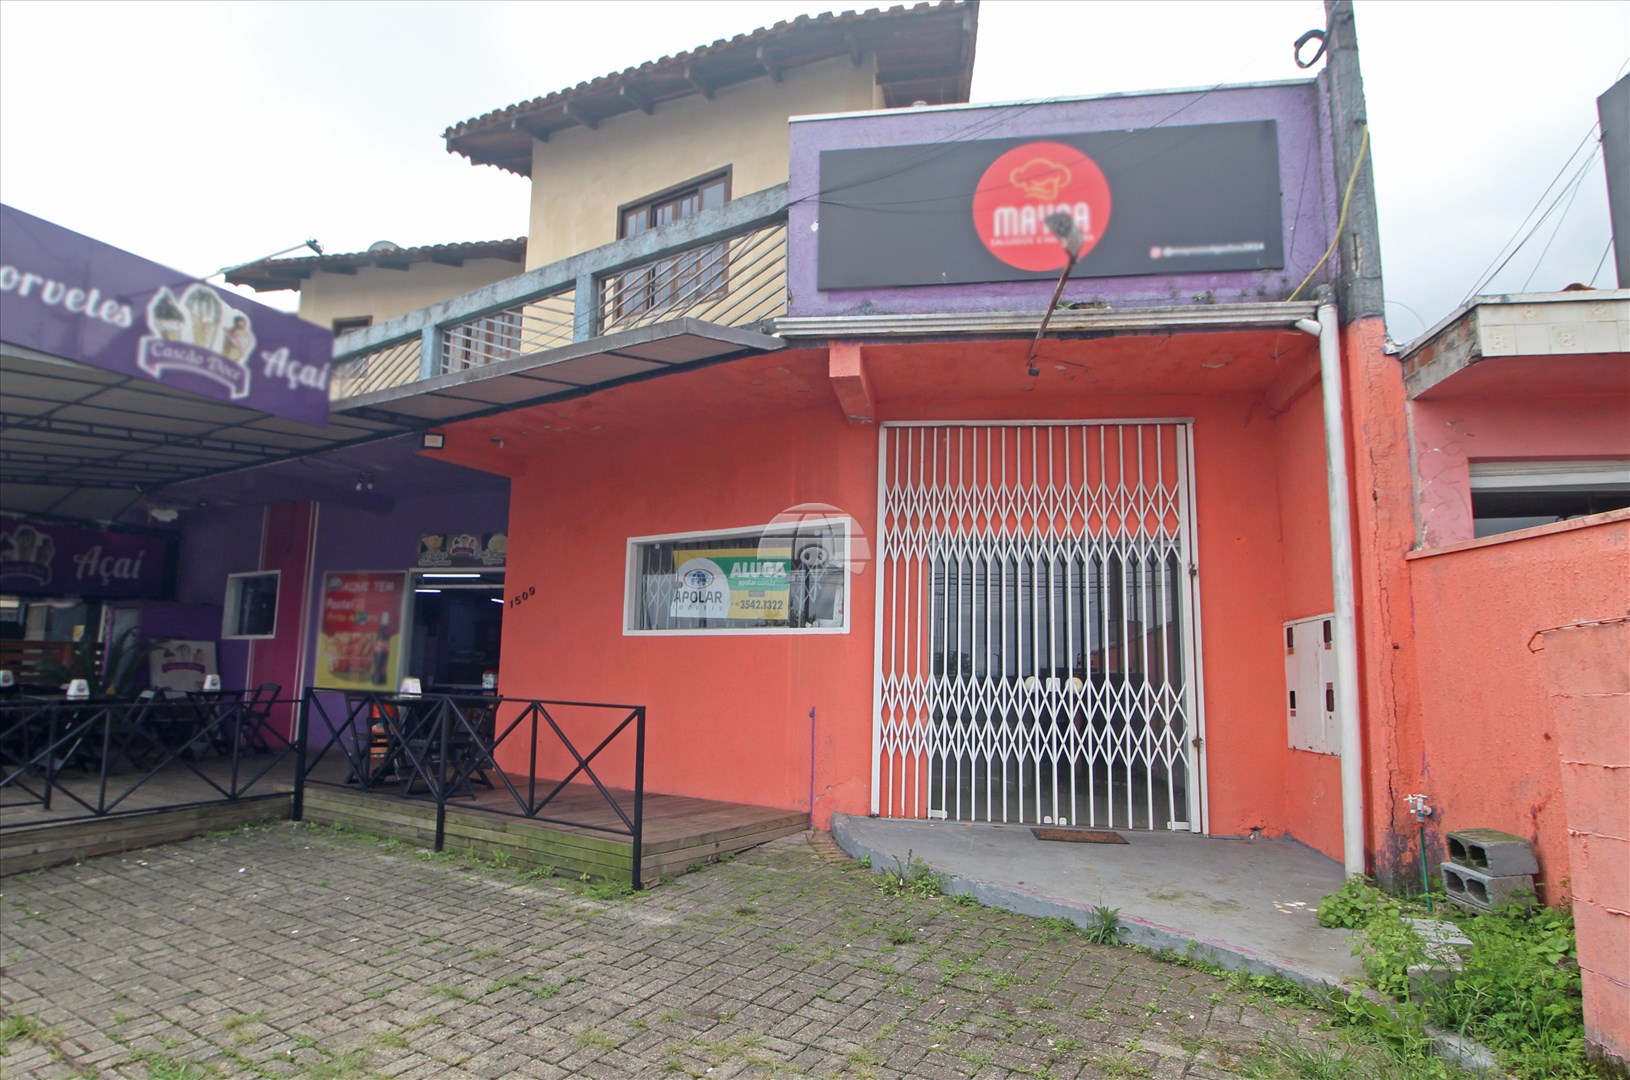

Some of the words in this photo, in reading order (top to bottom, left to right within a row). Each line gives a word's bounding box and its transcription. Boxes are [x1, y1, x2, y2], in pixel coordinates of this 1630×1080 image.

[993, 202, 1091, 237] MAYA
[260, 346, 331, 391] Açaí
[72, 545, 146, 587] Açaí
[729, 561, 787, 578] ALUGA
[509, 586, 536, 609] 1509
[673, 590, 723, 604] APOLAR
[740, 599, 784, 610] 3542.1322
